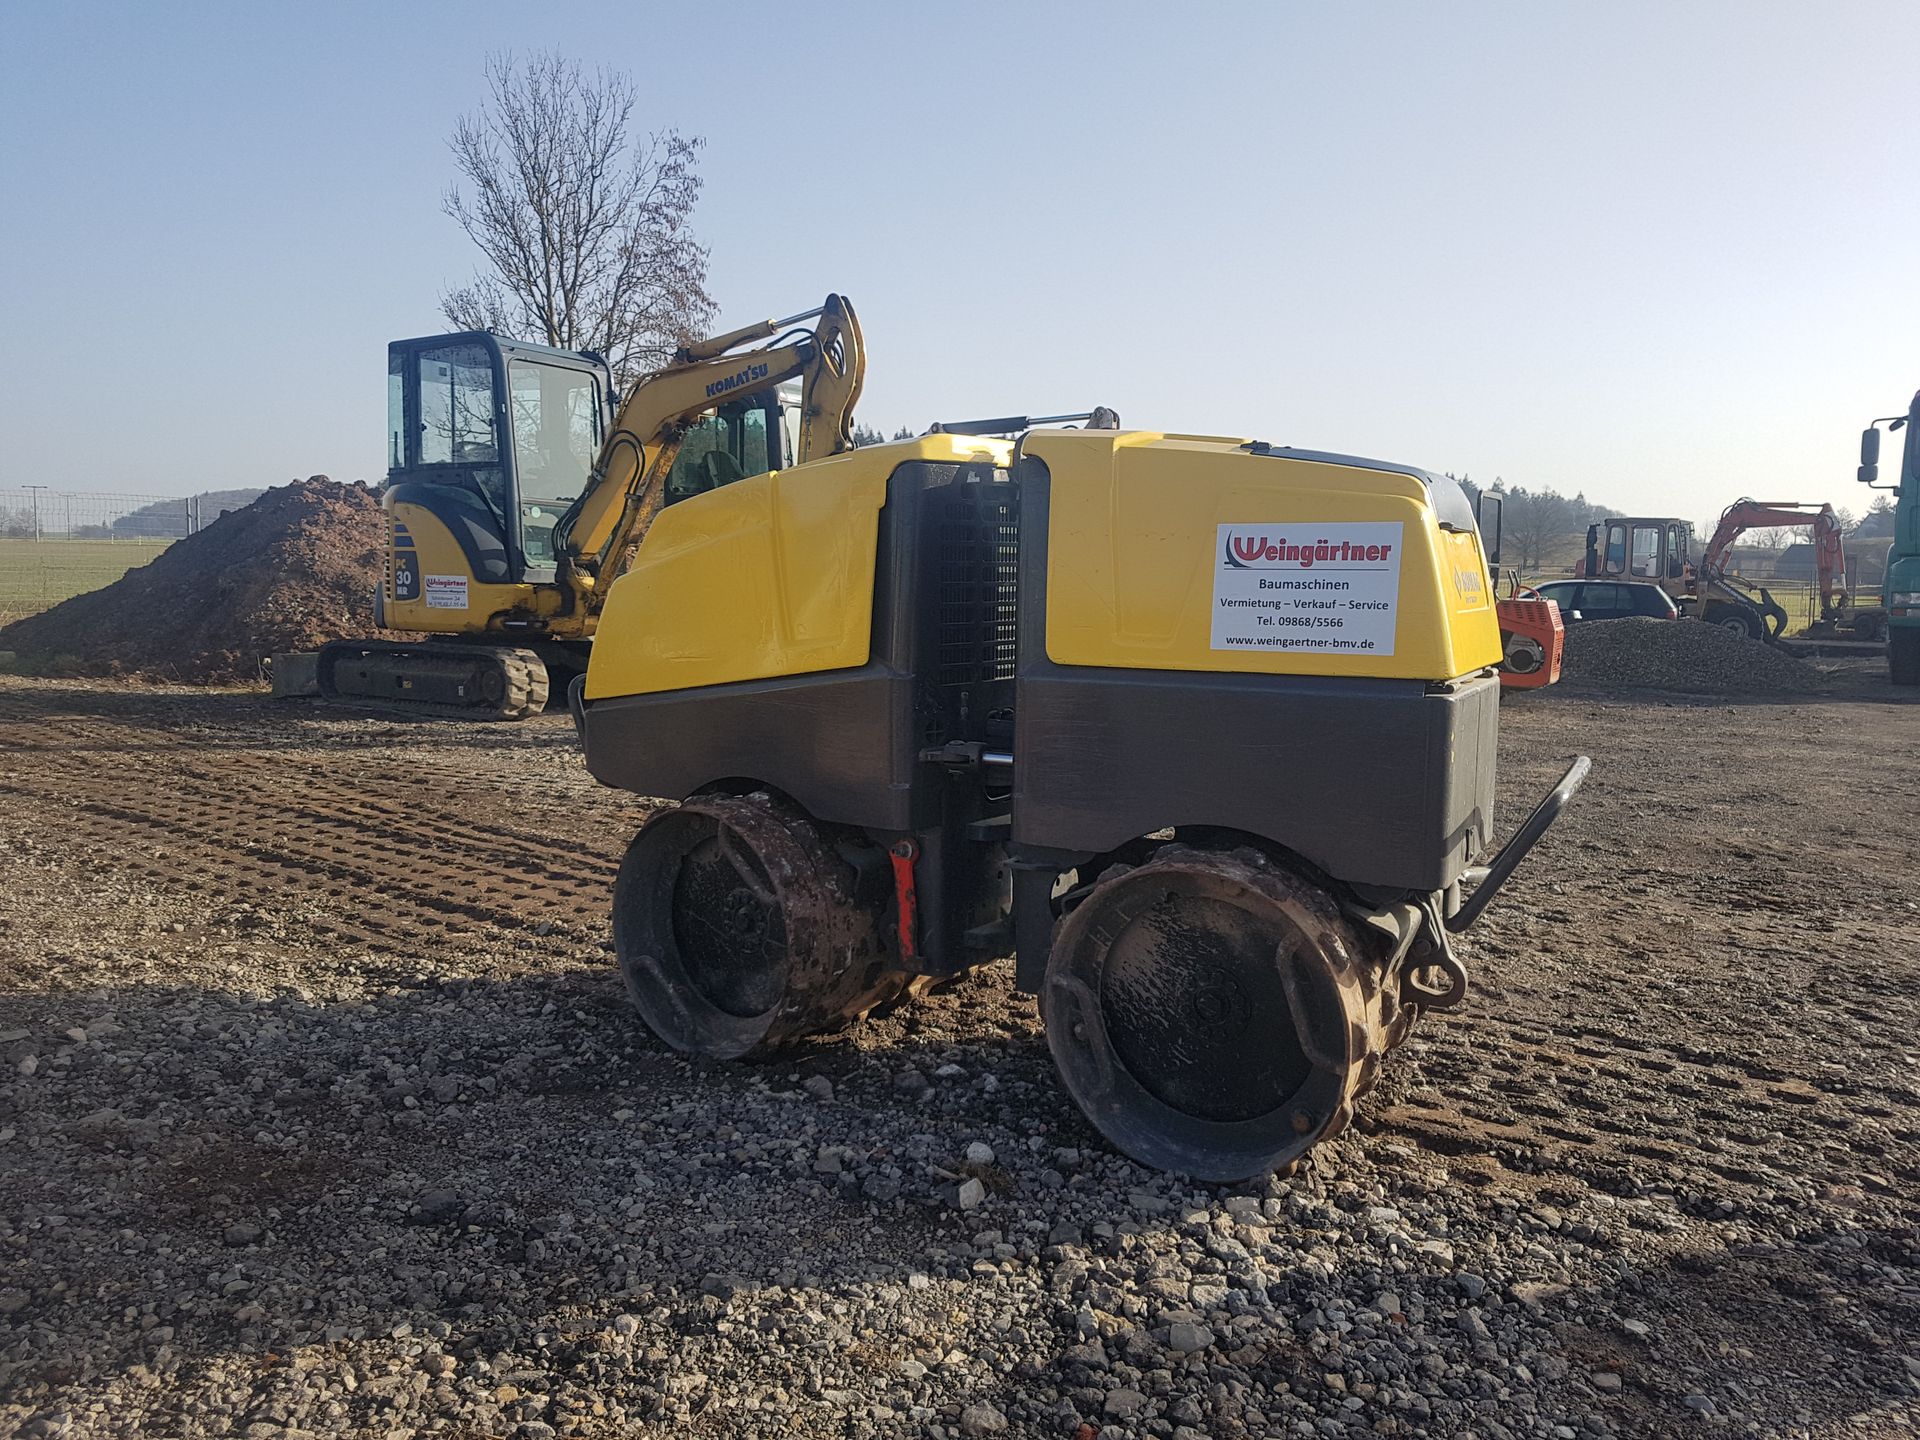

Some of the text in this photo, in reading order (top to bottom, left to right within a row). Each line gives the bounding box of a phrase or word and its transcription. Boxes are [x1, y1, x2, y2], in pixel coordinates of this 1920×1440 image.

[706, 363, 768, 397] KOMATSU
[1233, 537, 1391, 568] Weingärtner
[395, 558, 406, 569] PC
[396, 571, 411, 585] 30
[1259, 578, 1350, 590] Baumaschinen
[1220, 598, 1281, 610] Vermietung
[1293, 599, 1337, 610] Verkauf
[1348, 600, 1389, 610] Service
[1257, 616, 1344, 628] Tel. 09868/5566
[1225, 637, 1375, 649] www.weingaertner-bmv.de
